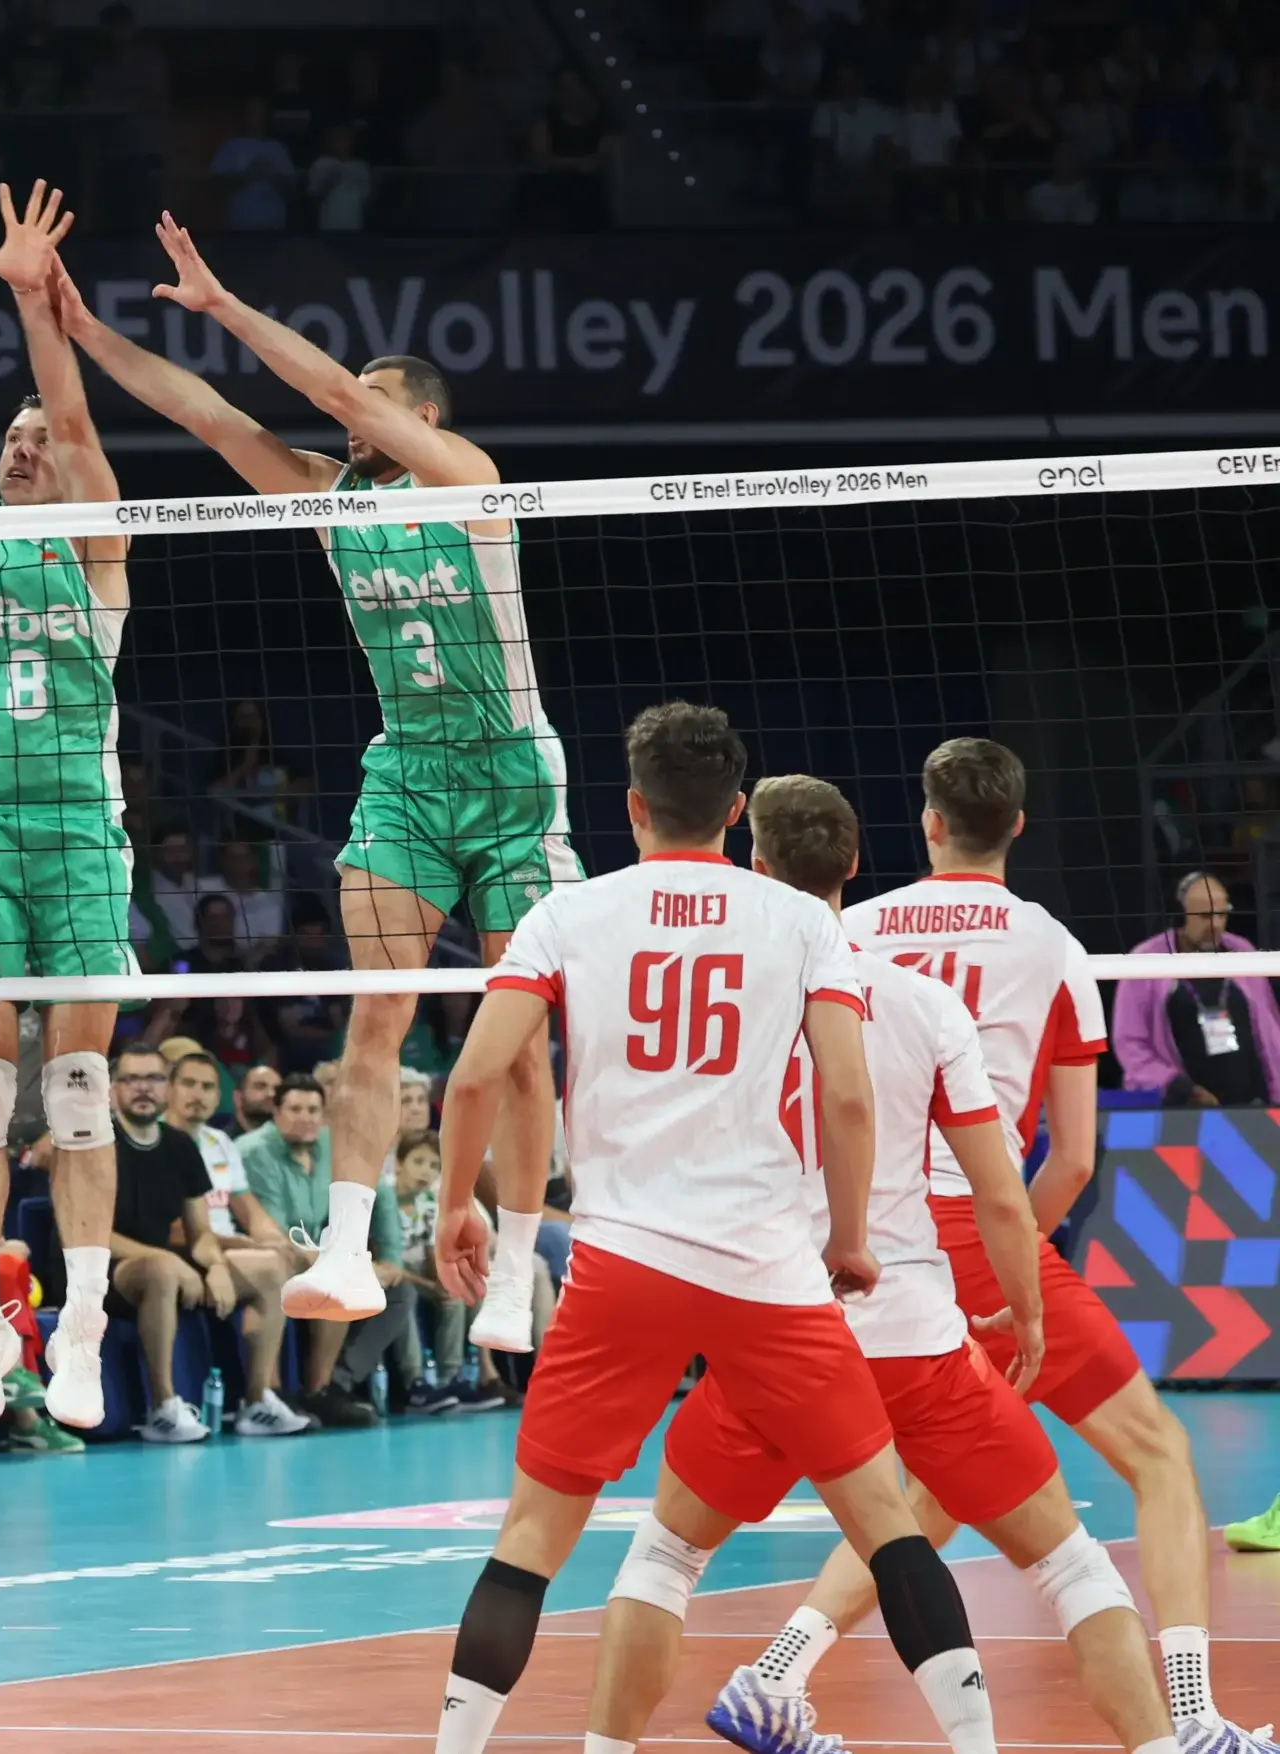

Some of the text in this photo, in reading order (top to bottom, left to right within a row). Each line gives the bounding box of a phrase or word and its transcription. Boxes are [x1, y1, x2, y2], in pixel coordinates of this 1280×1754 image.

[94, 268, 695, 396] EuroVolley
[735, 267, 996, 368] 2026
[1034, 265, 1265, 361] Men
[1038, 460, 1105, 488] enel
[1217, 455, 1257, 475] CEV
[481, 486, 544, 513] enel
[650, 471, 928, 501] CEV Enel EuroVolley 2026 Men
[116, 497, 377, 524] CEV Enel EuroVolley 2026 Men
[401, 620, 446, 688] 3
[6, 649, 48, 721] 8
[650, 890, 727, 928] FIRLEJ
[875, 904, 1011, 936] JAKUBISZAK
[626, 951, 744, 1076] 96
